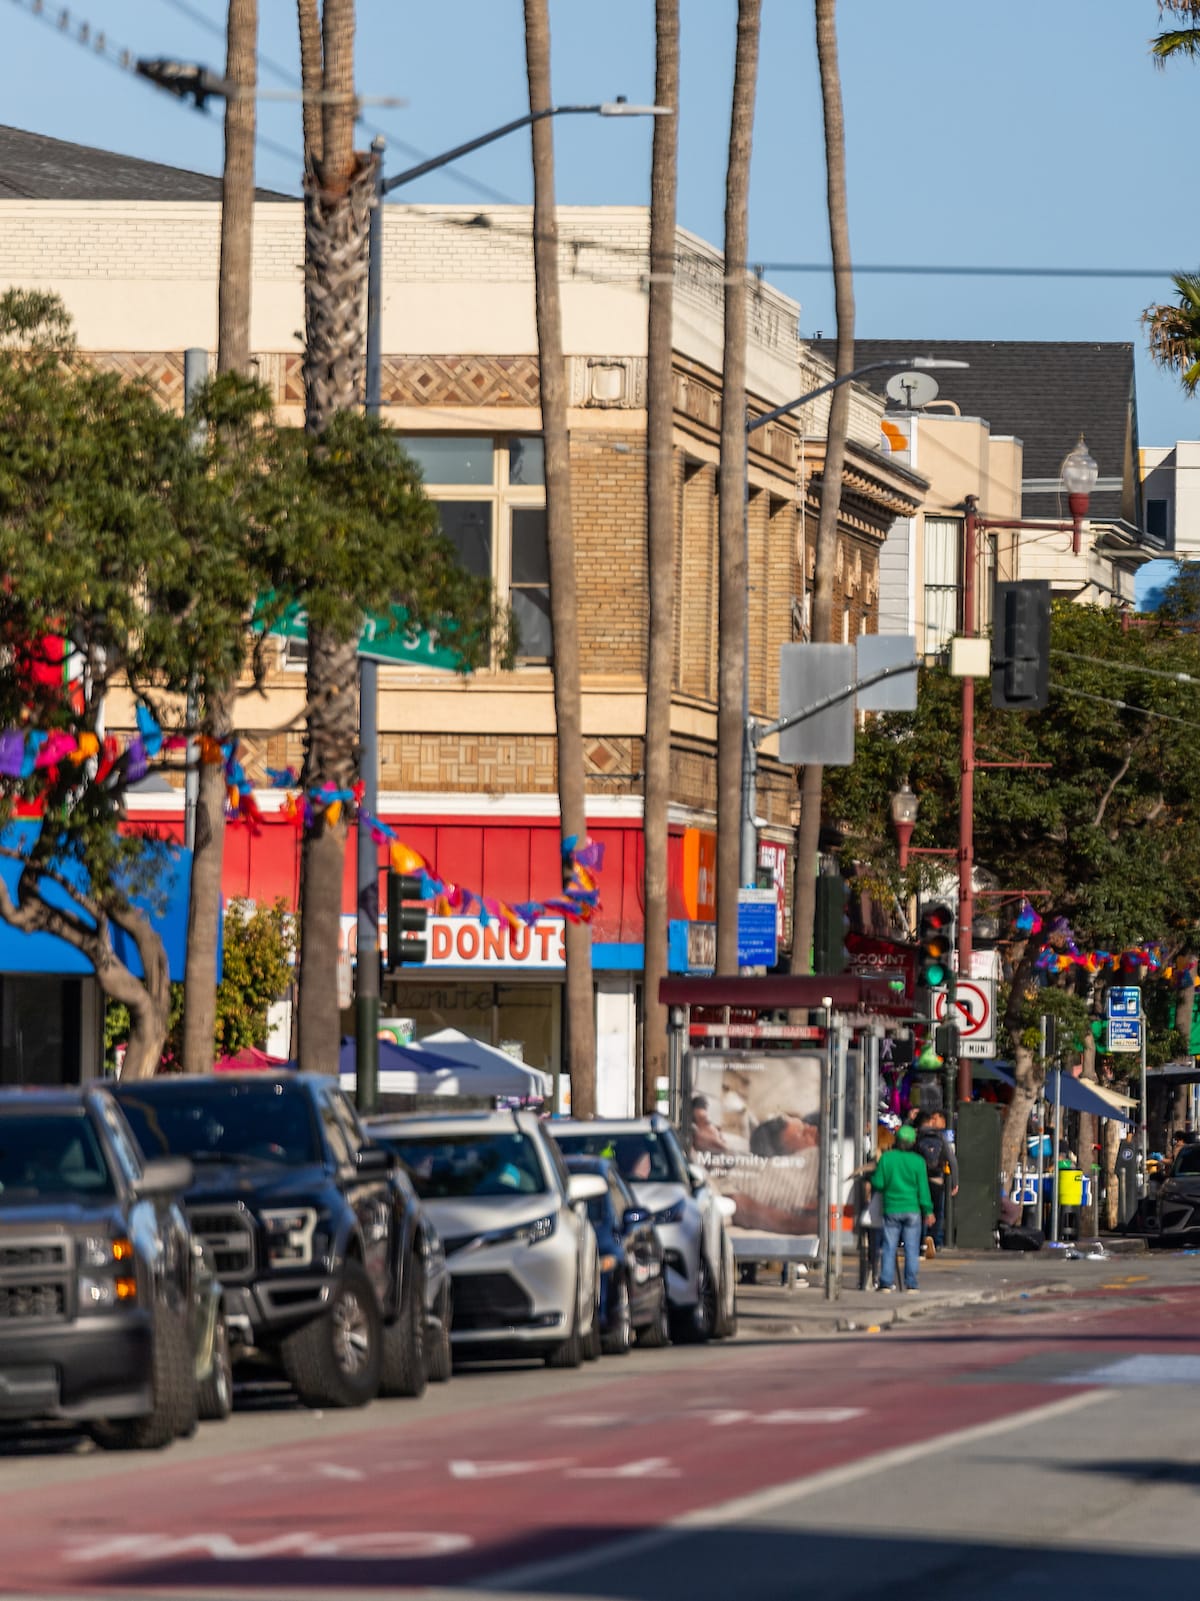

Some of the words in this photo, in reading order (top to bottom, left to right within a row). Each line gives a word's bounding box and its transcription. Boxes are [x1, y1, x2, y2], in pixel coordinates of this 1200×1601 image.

[968, 1044, 990, 1054] MUNI
[697, 1151, 768, 1171] Maternity
[771, 1155, 805, 1168] care
